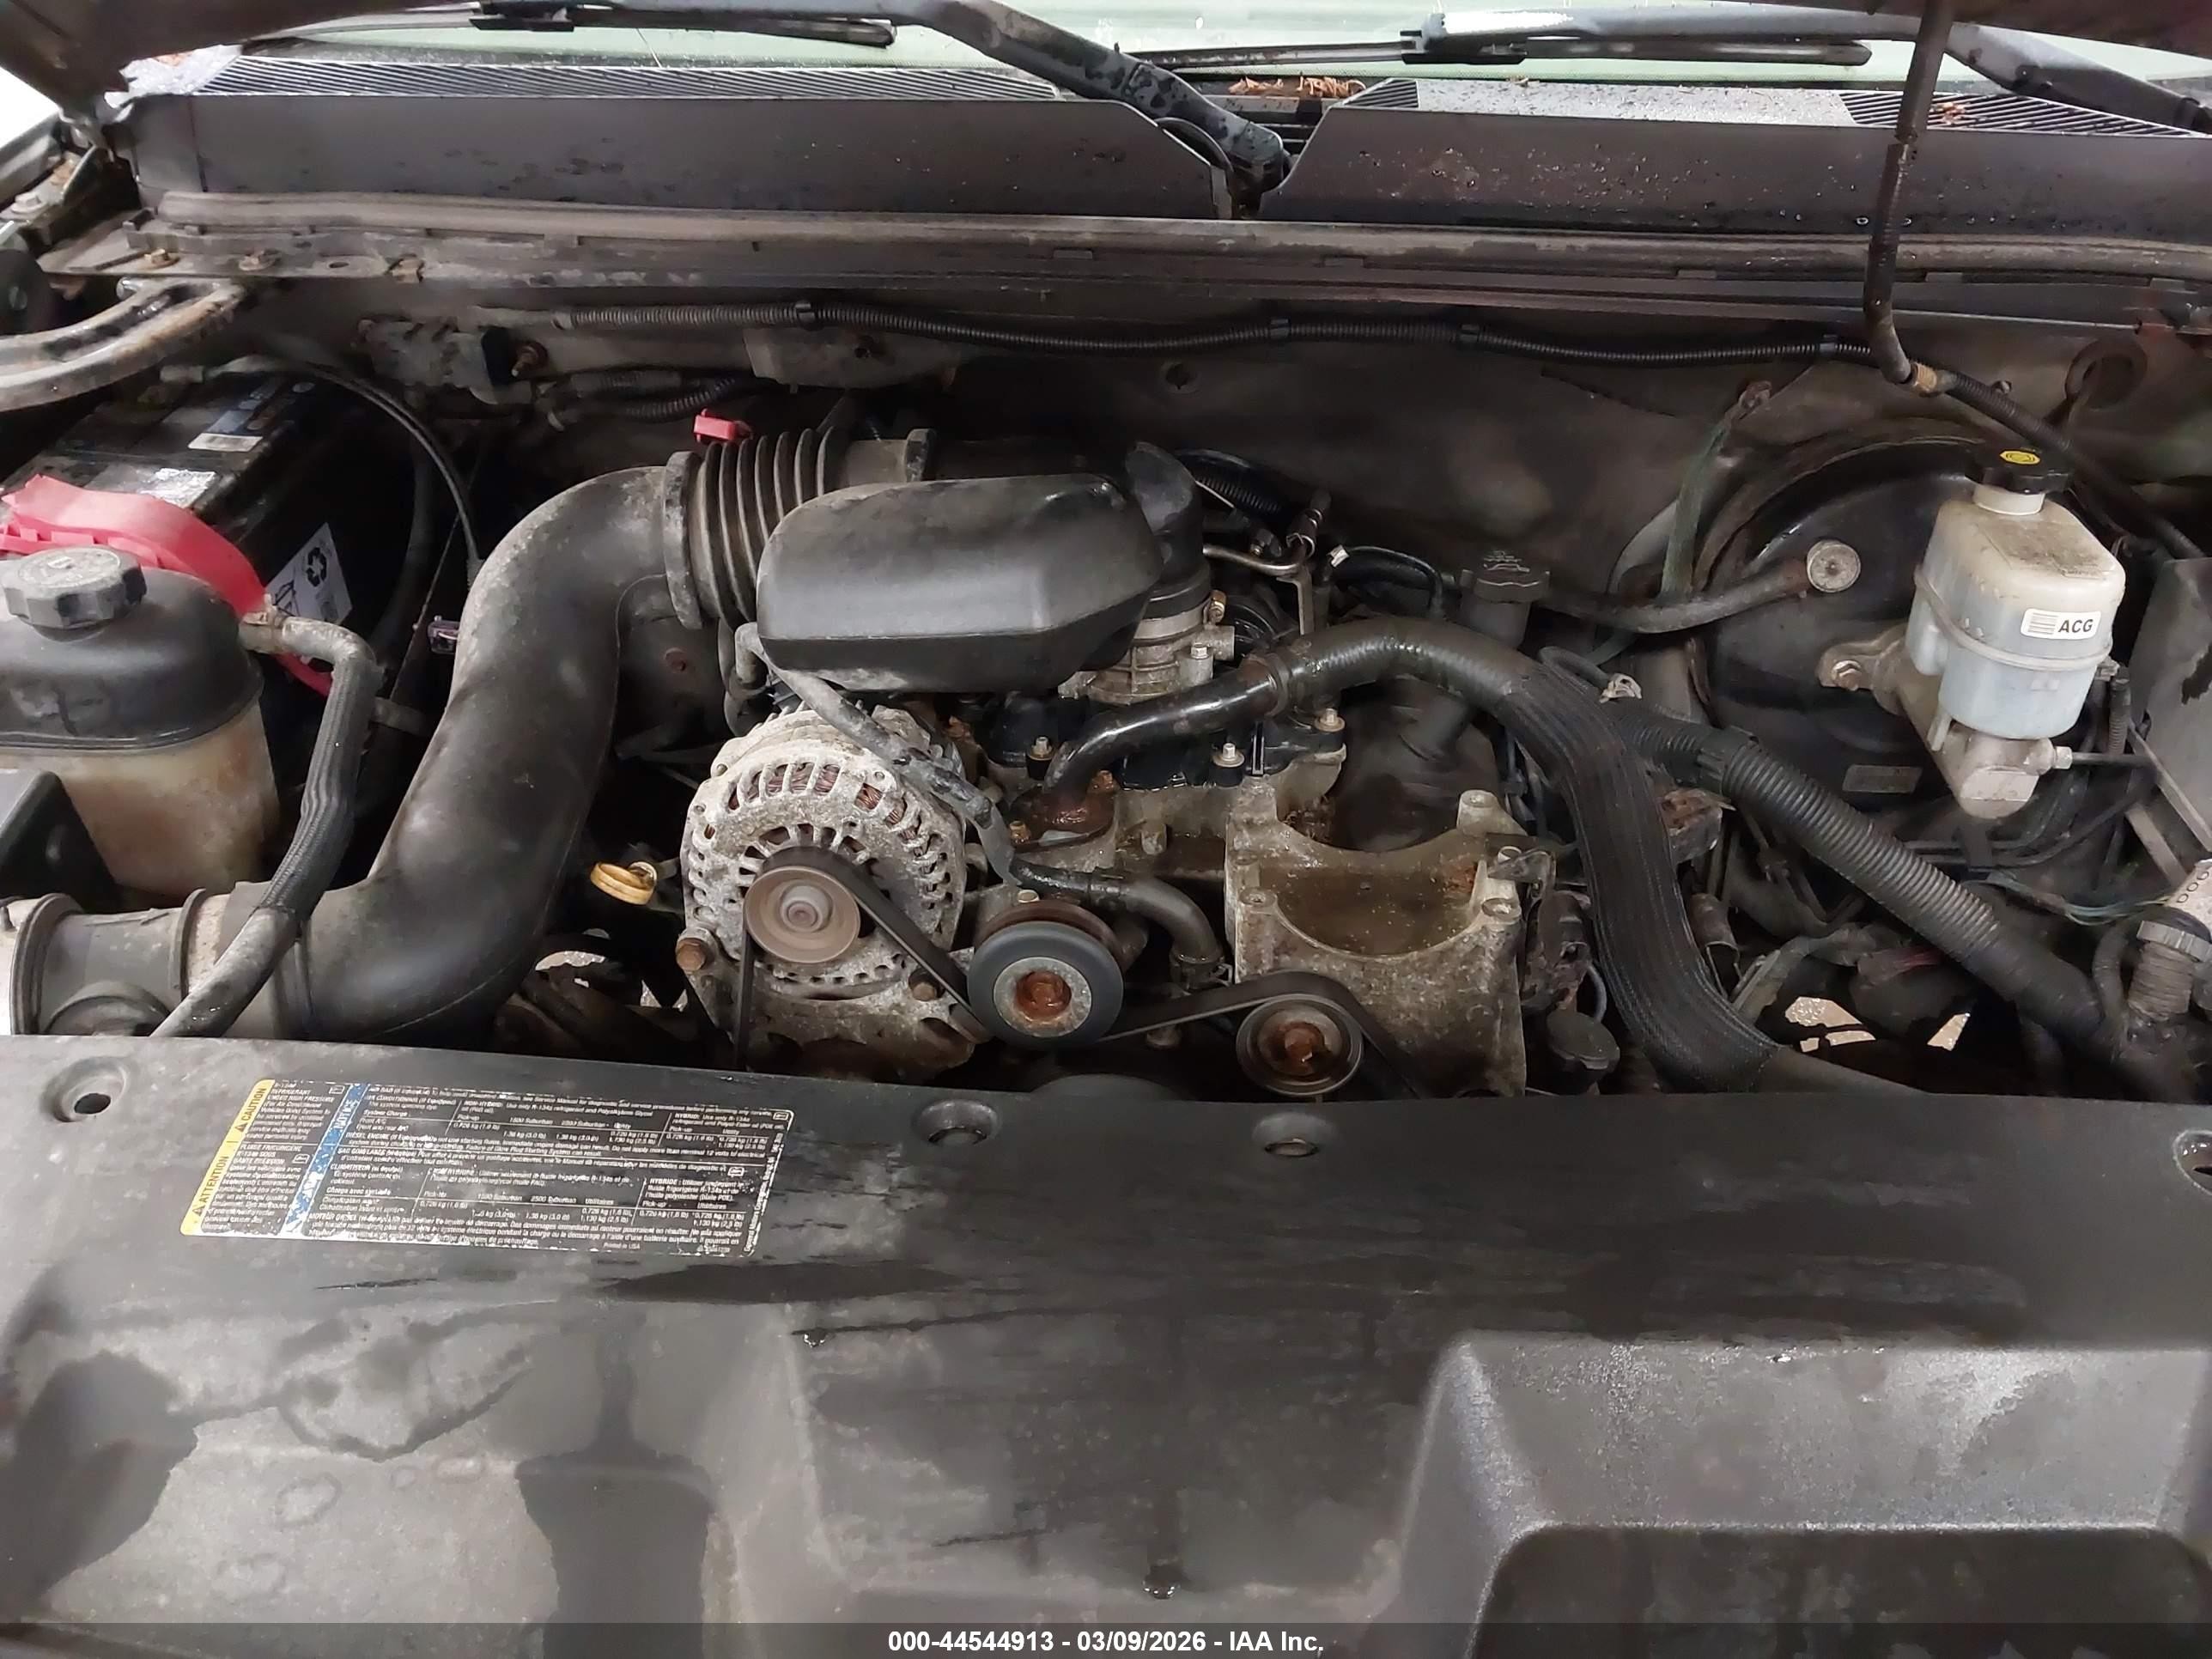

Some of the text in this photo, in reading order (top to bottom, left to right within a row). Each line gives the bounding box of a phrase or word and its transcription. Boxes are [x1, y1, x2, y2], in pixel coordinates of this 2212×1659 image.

[2058, 619, 2094, 633] ACG
[241, 1088, 266, 1121] CAUTION
[200, 1156, 230, 1203] ATTENTION
